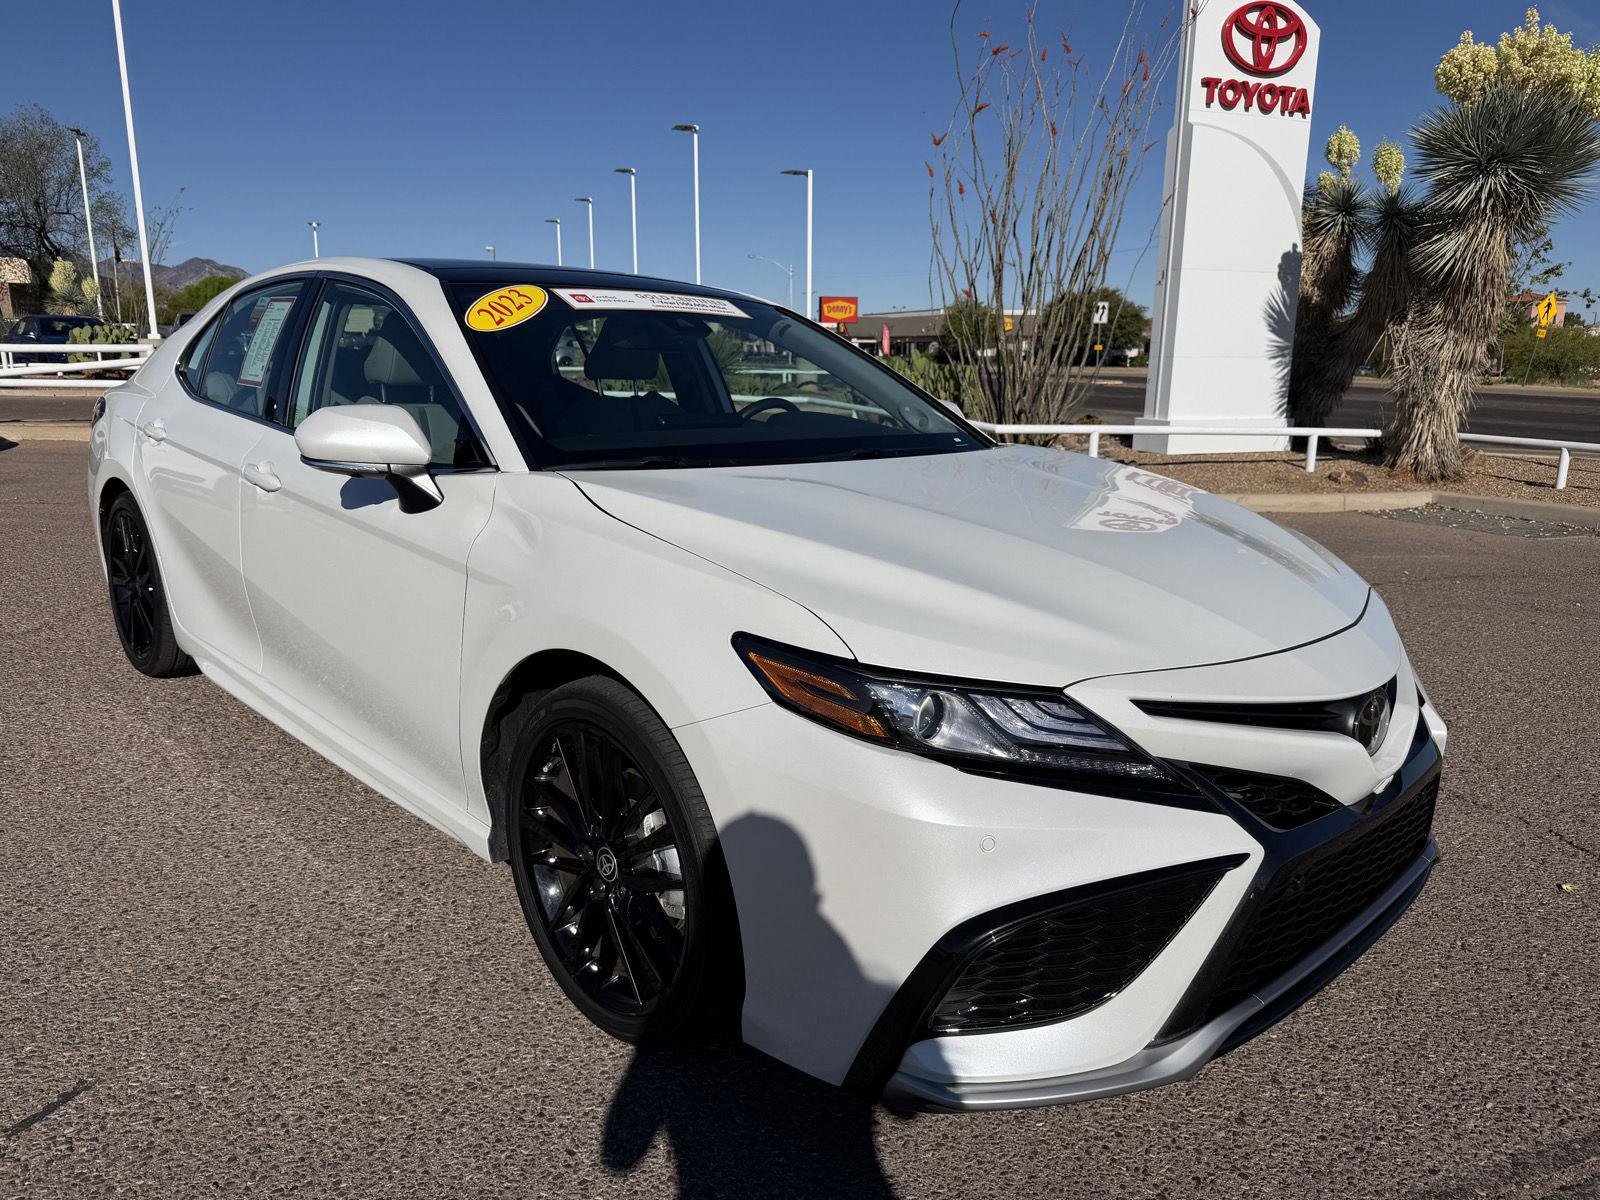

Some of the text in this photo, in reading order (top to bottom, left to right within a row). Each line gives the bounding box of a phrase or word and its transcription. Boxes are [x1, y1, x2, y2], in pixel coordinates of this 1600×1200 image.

[1201, 77, 1310, 119] TOYOTA
[477, 289, 532, 326] 2023
[635, 293, 670, 301] GOLD
[826, 304, 853, 315] Denny's
